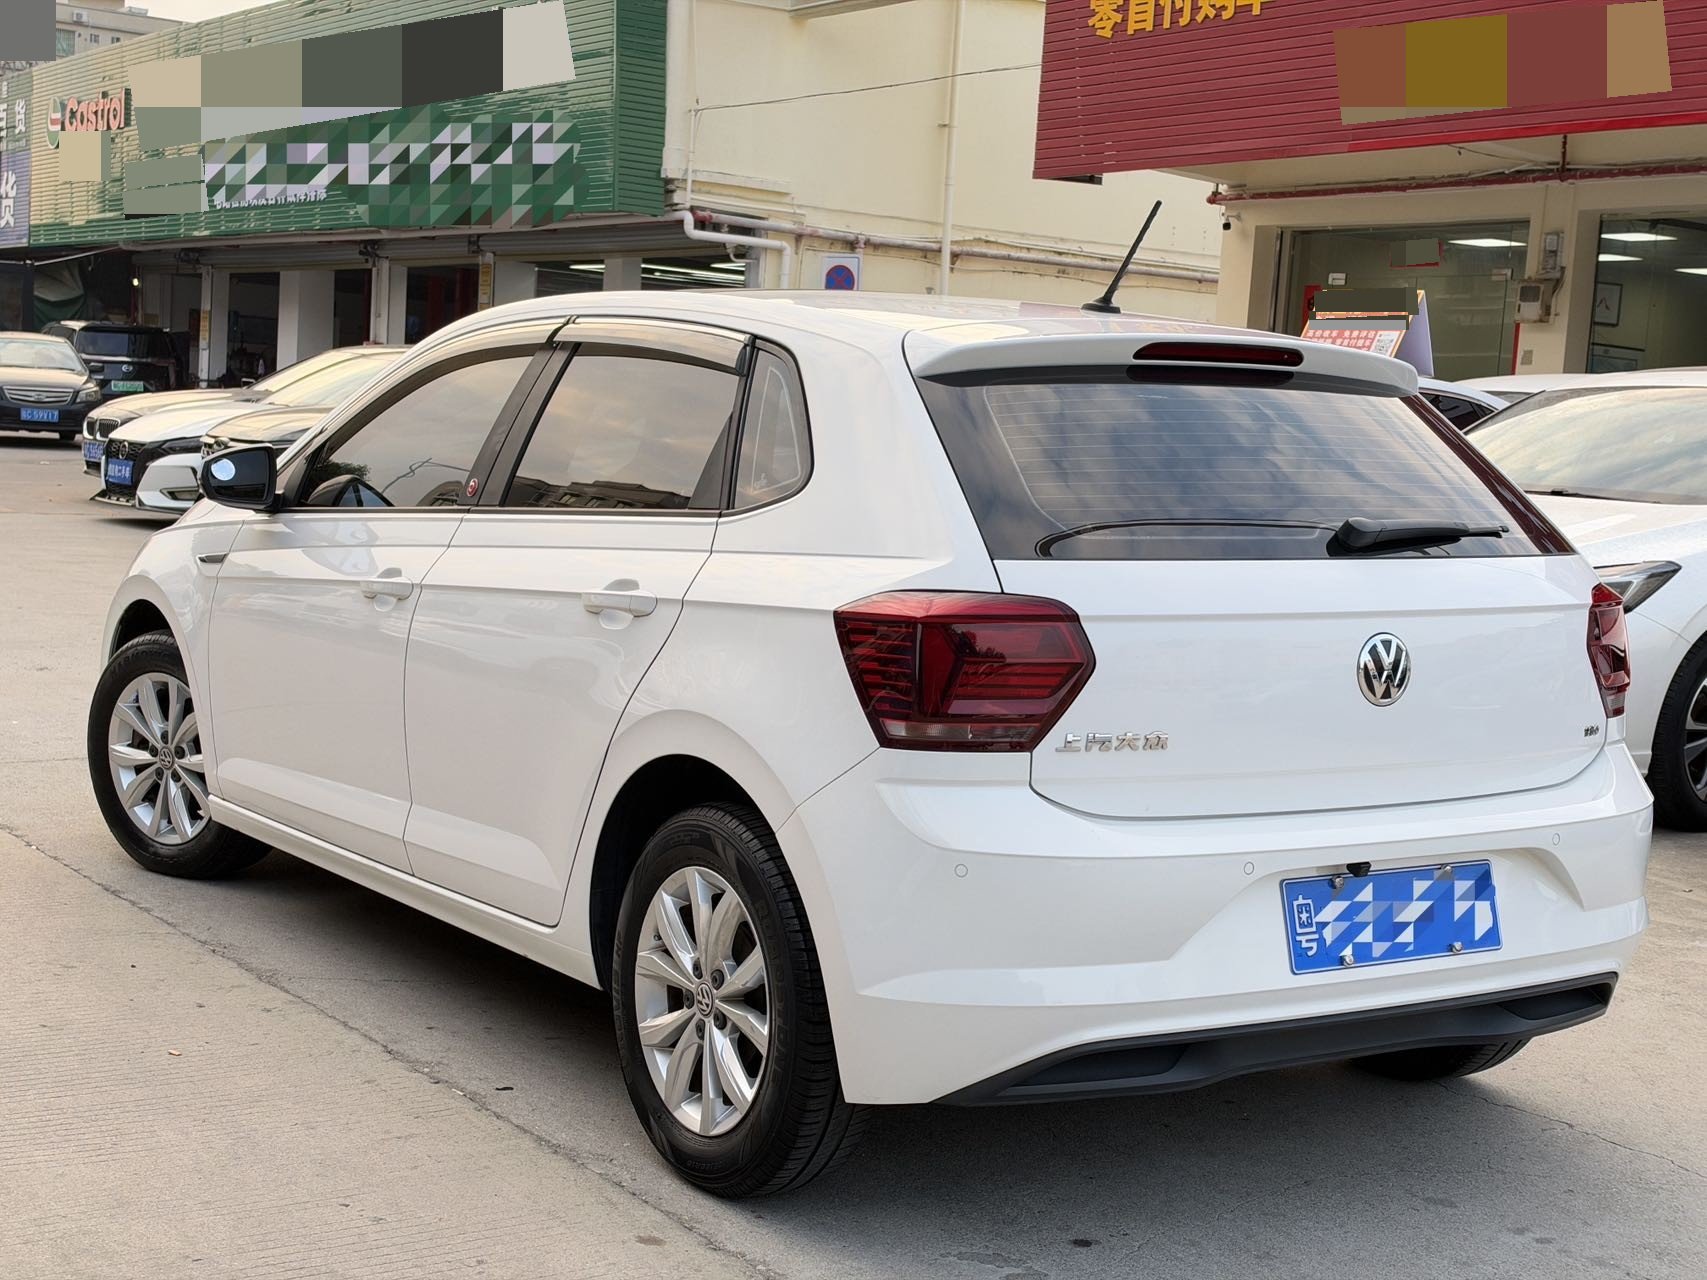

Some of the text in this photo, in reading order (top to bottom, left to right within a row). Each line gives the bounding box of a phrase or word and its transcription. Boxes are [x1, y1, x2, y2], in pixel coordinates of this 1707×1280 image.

[1088, 0, 1272, 38] 零首付
[64, 87, 126, 132] Castrol
[1055, 730, 1169, 753] 上汽大众
